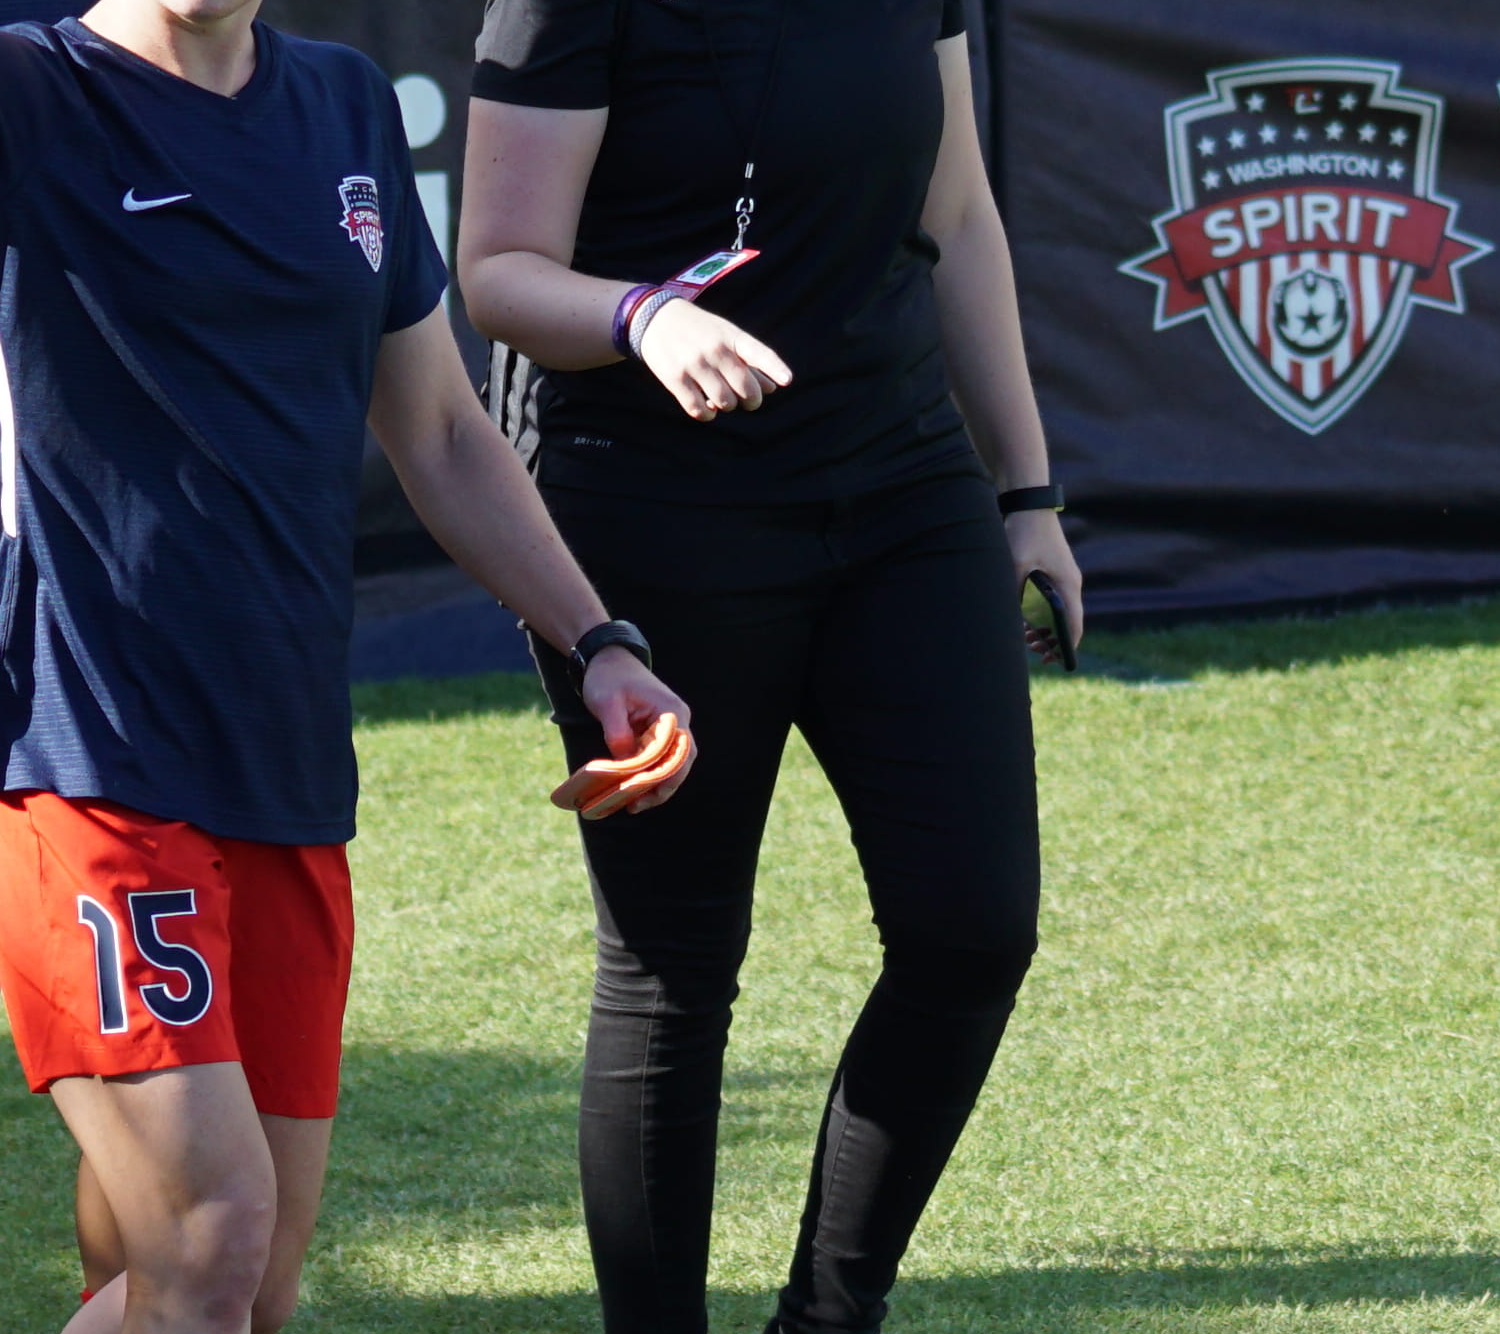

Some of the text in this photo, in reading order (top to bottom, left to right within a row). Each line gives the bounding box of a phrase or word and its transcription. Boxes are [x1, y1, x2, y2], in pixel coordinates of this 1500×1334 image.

[1226, 151, 1382, 186] WASHINGTON
[1203, 192, 1409, 259] SPIRIT
[77, 887, 213, 1035] 15
